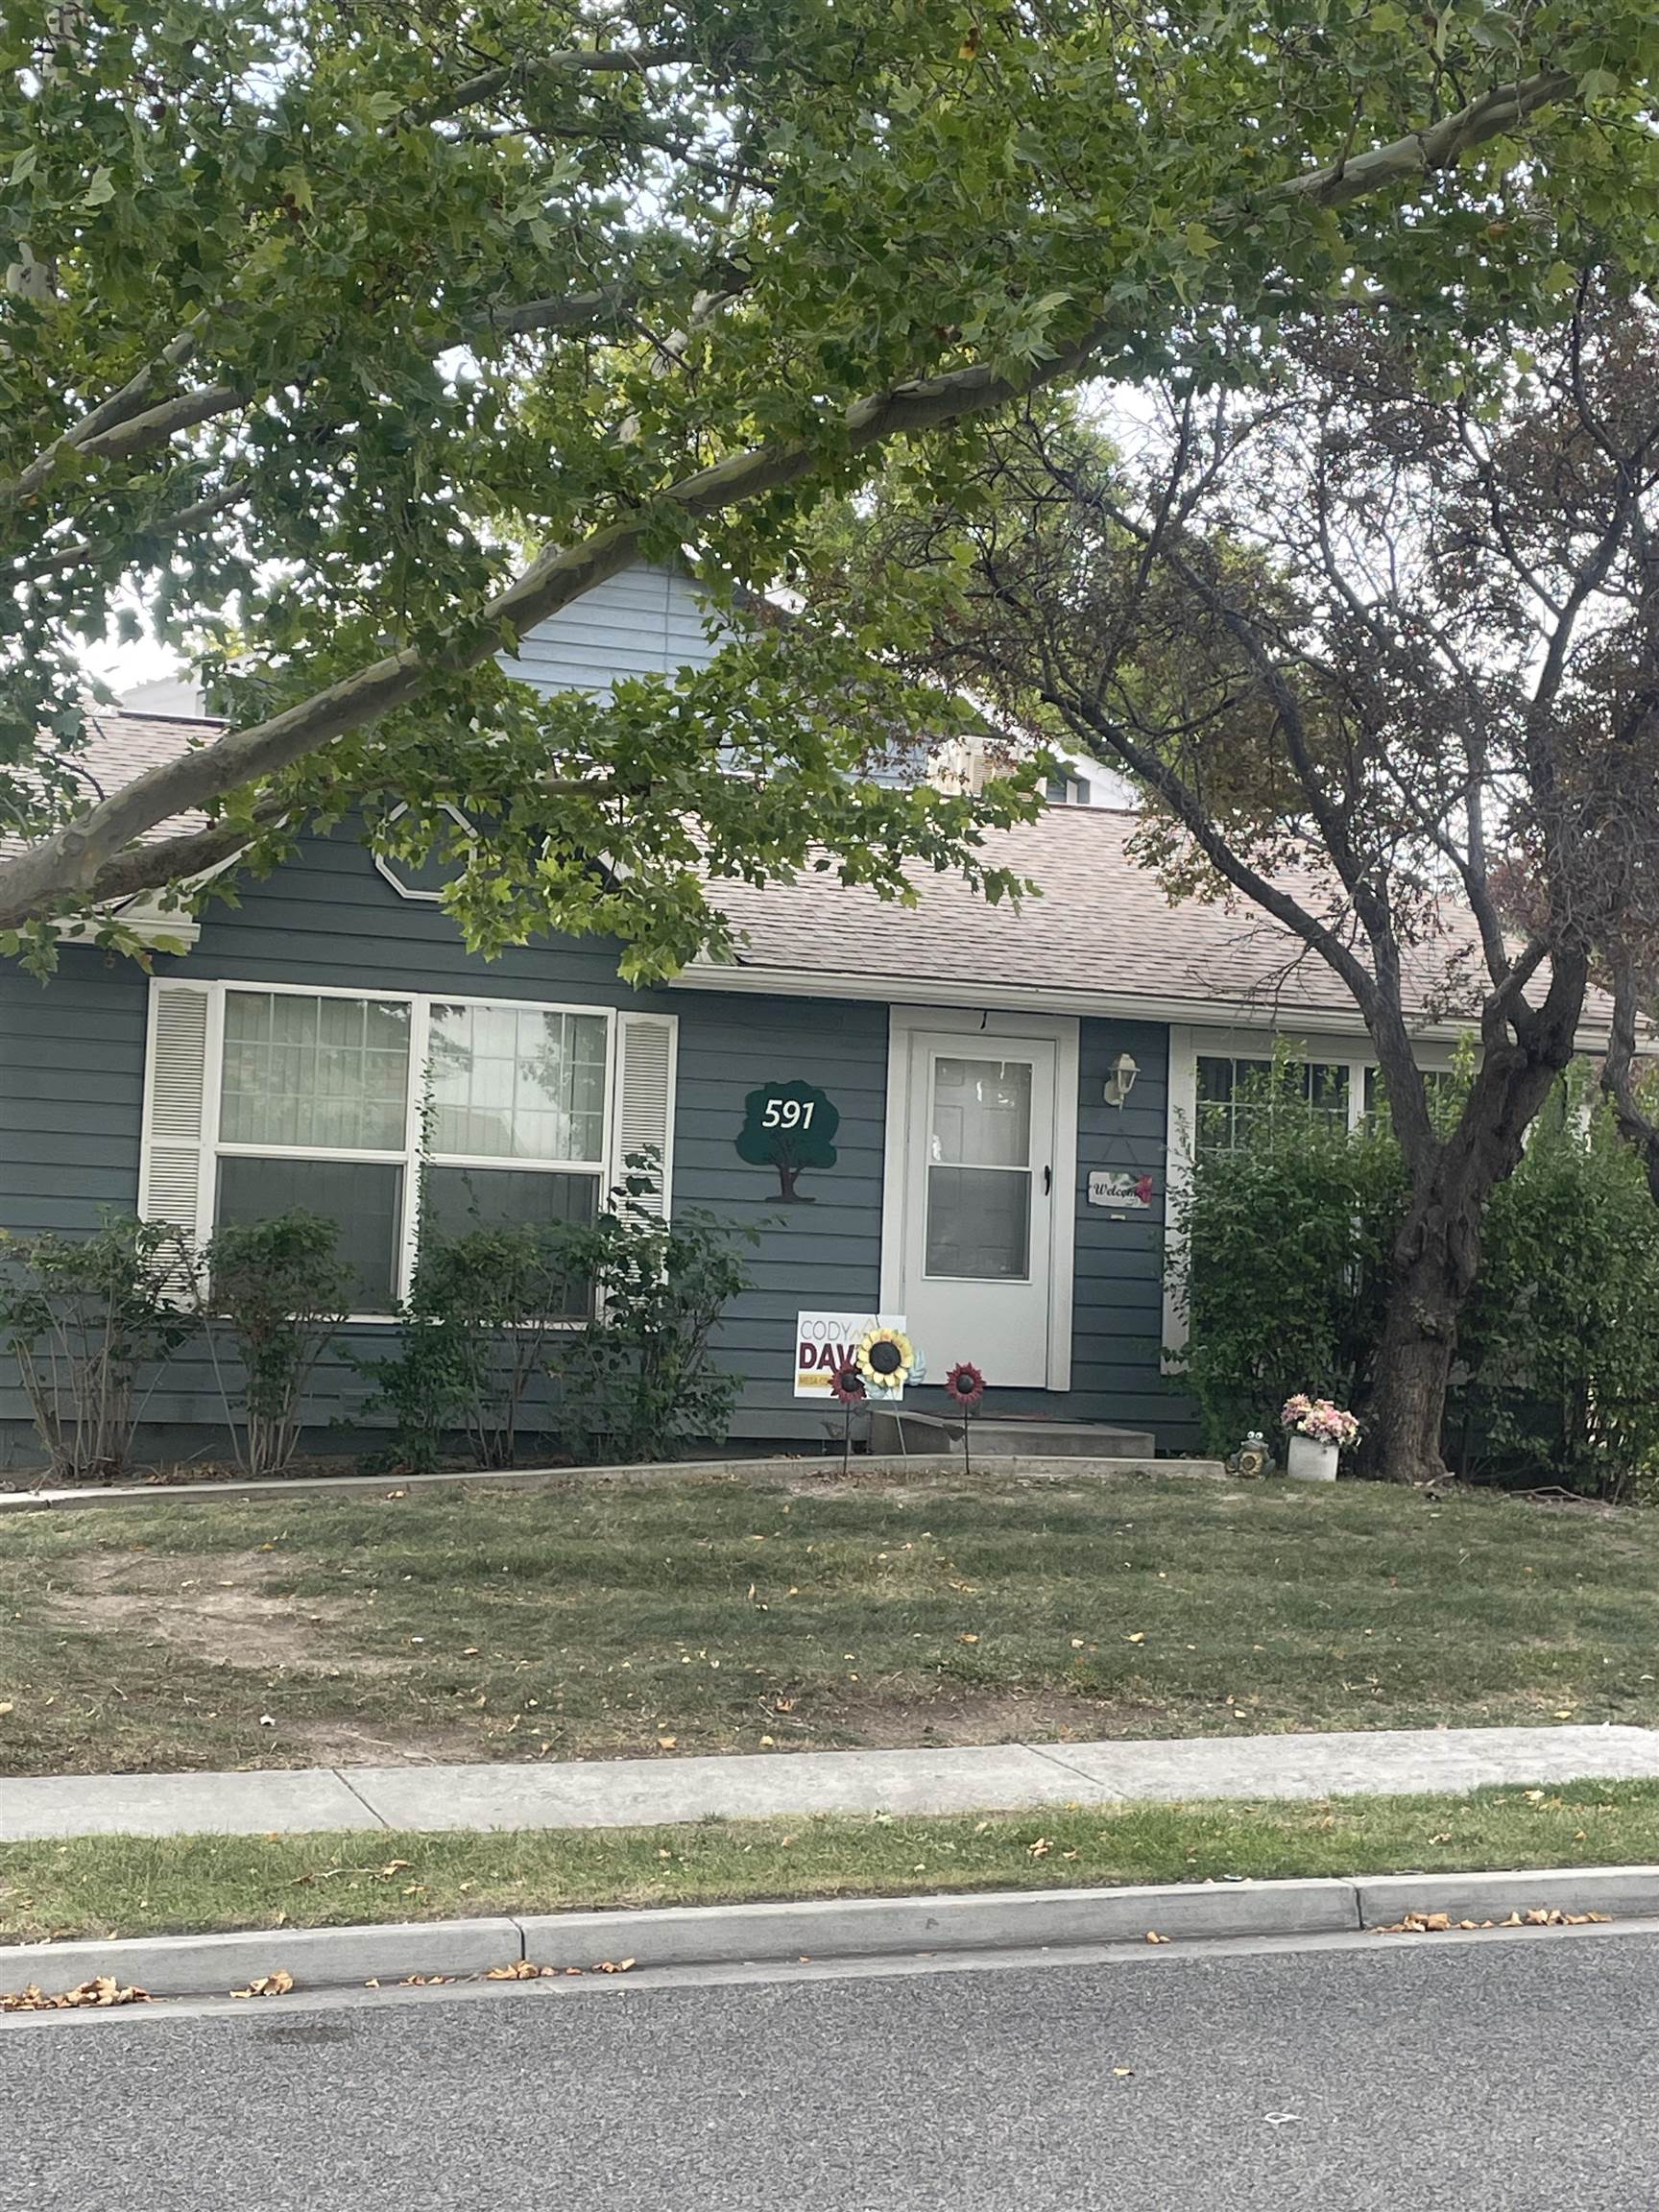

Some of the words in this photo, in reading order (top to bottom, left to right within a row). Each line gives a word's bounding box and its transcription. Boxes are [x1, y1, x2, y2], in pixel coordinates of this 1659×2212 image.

[761, 1099, 815, 1130] 591
[1094, 1183, 1140, 1197] Welcom
[800, 1320, 852, 1341] CODY
[799, 1342, 855, 1373] DAV
